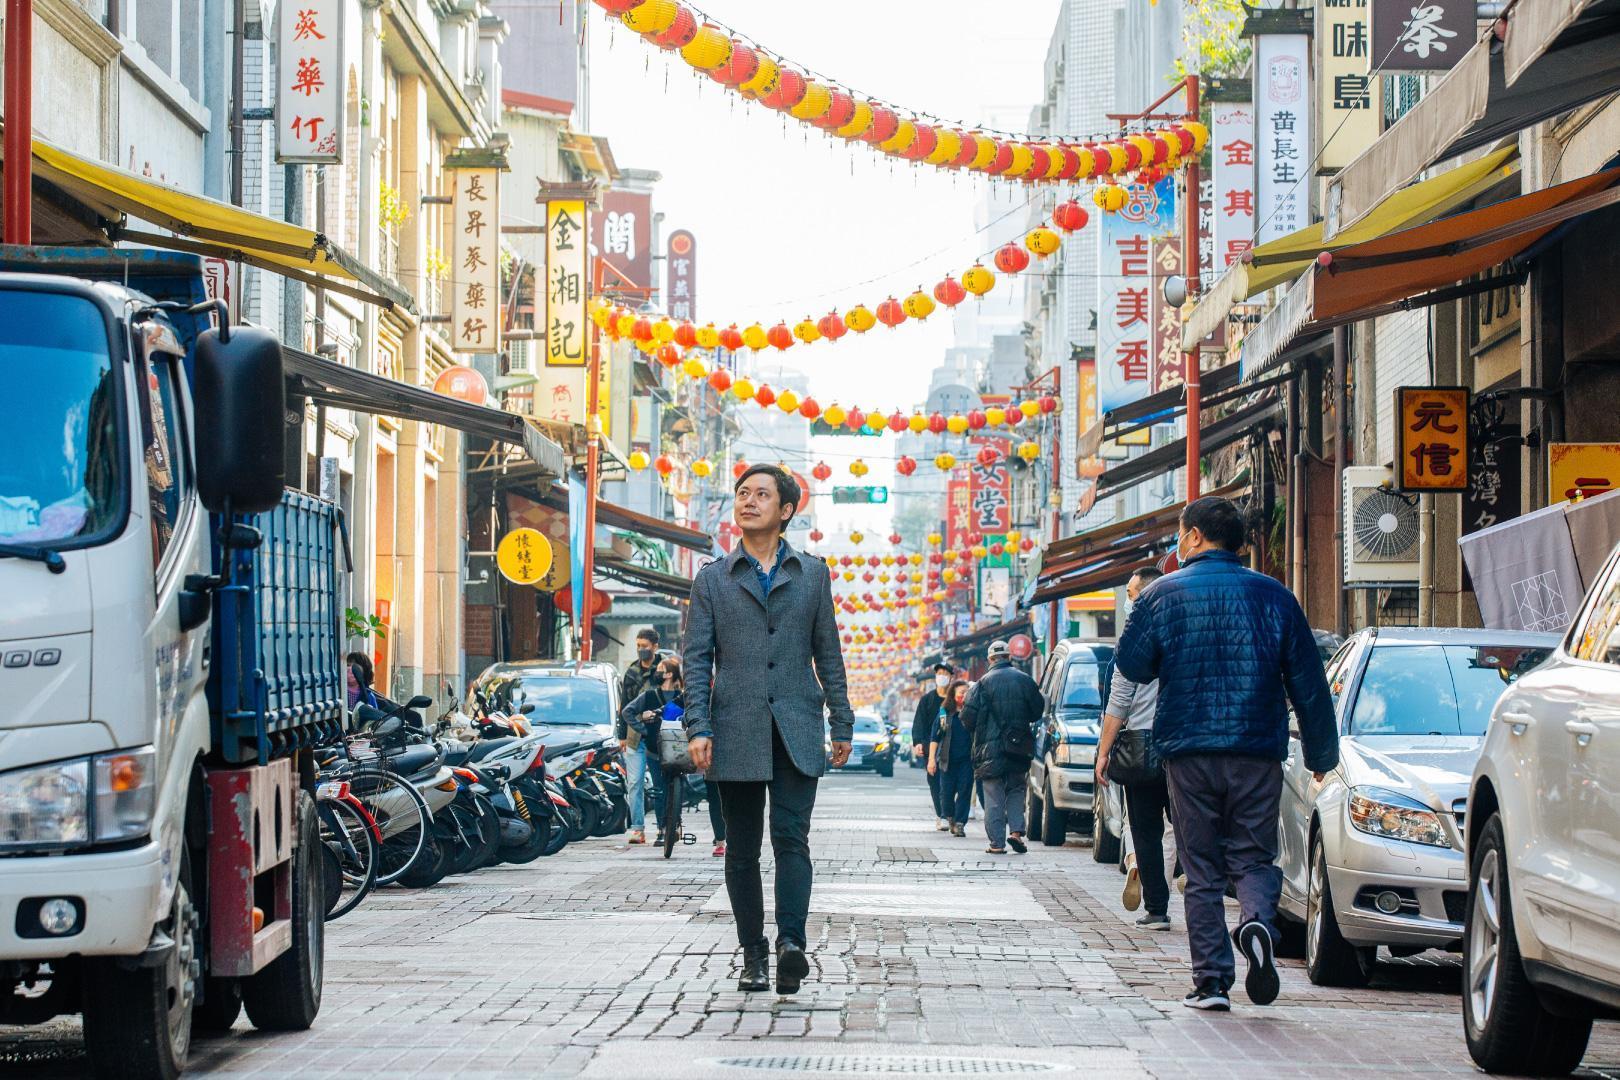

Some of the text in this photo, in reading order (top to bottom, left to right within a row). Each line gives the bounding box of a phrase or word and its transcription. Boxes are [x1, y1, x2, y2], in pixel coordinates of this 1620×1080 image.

[1333, 21, 1370, 109] 味島
[1396, 5, 1458, 59] 茶
[550, 208, 582, 359] 金湘記
[1116, 234, 1148, 381] 吉美香
[1410, 402, 1459, 476] 元信
[0, 648, 61, 668] 00
